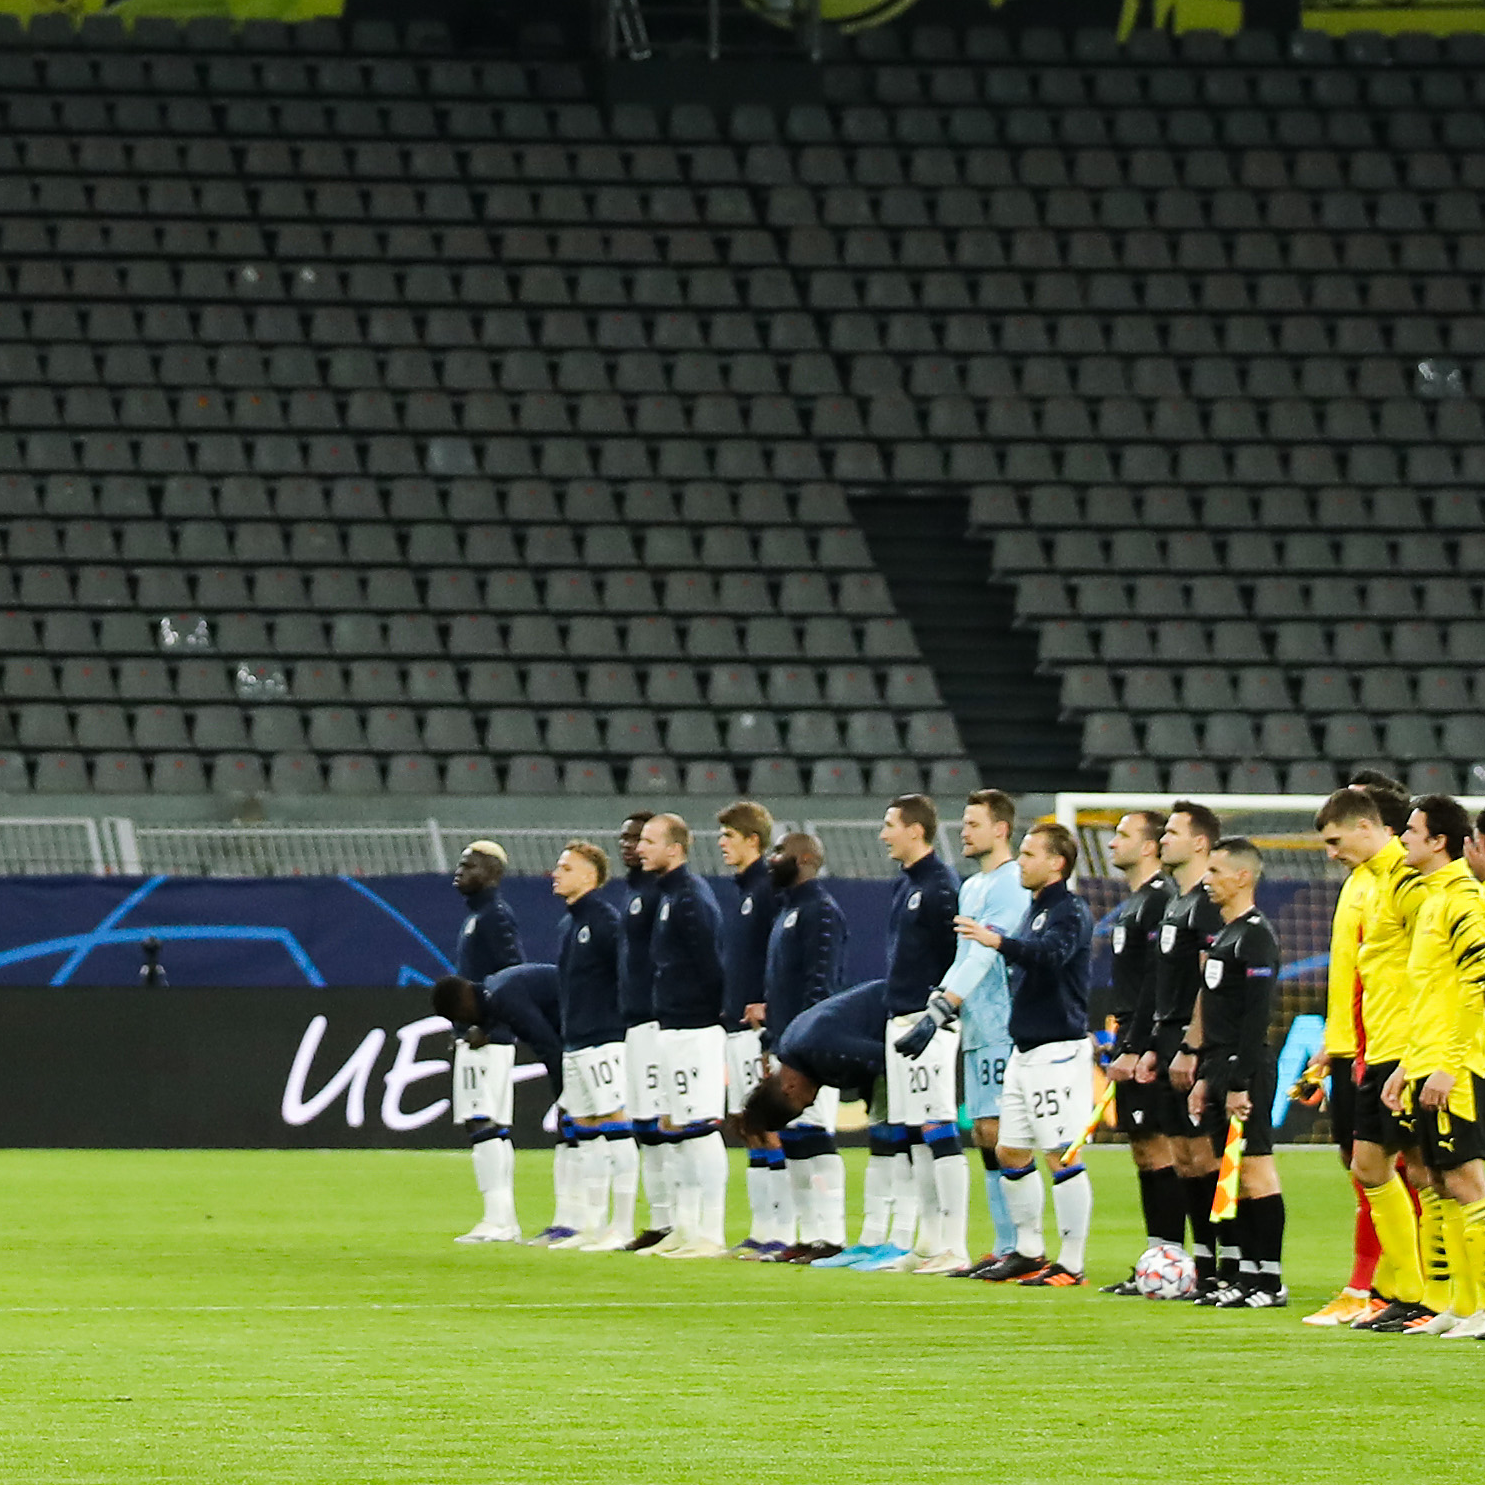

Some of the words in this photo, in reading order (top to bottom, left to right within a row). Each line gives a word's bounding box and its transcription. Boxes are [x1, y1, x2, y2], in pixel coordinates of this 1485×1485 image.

[589, 1060, 613, 1088] 10
[674, 1069, 689, 1095] 9
[909, 1065, 929, 1094] 20
[1032, 1089, 1059, 1119] 25
